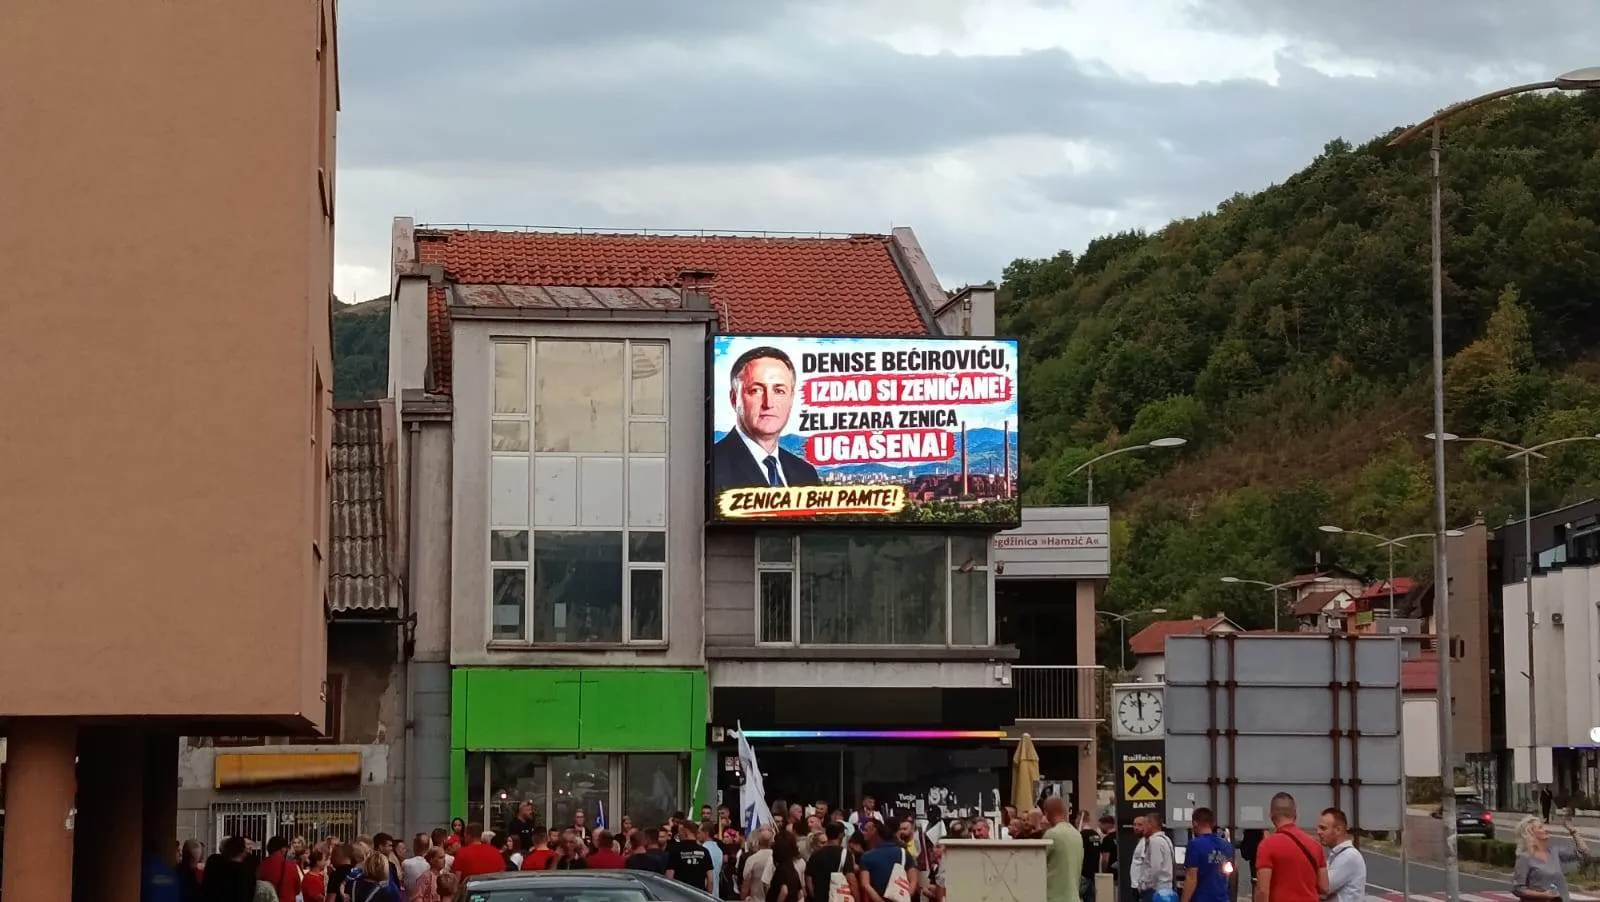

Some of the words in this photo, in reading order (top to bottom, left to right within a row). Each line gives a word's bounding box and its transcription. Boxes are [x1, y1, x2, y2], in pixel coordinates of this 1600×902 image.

[802, 352, 877, 373] DENISE
[881, 346, 1010, 372] BEĆIROVIĆU,
[811, 379, 872, 402] IZDAO
[877, 379, 897, 401] SI
[900, 374, 1006, 402] ZENIČANE!
[799, 409, 894, 431] ŽELJEZARA
[898, 409, 958, 429] ZENICA
[814, 431, 948, 461] UGAŠENA!
[729, 492, 791, 511] ZENICA
[796, 491, 802, 508] I
[807, 490, 833, 507] BiH
[837, 489, 898, 507] PAMTE!
